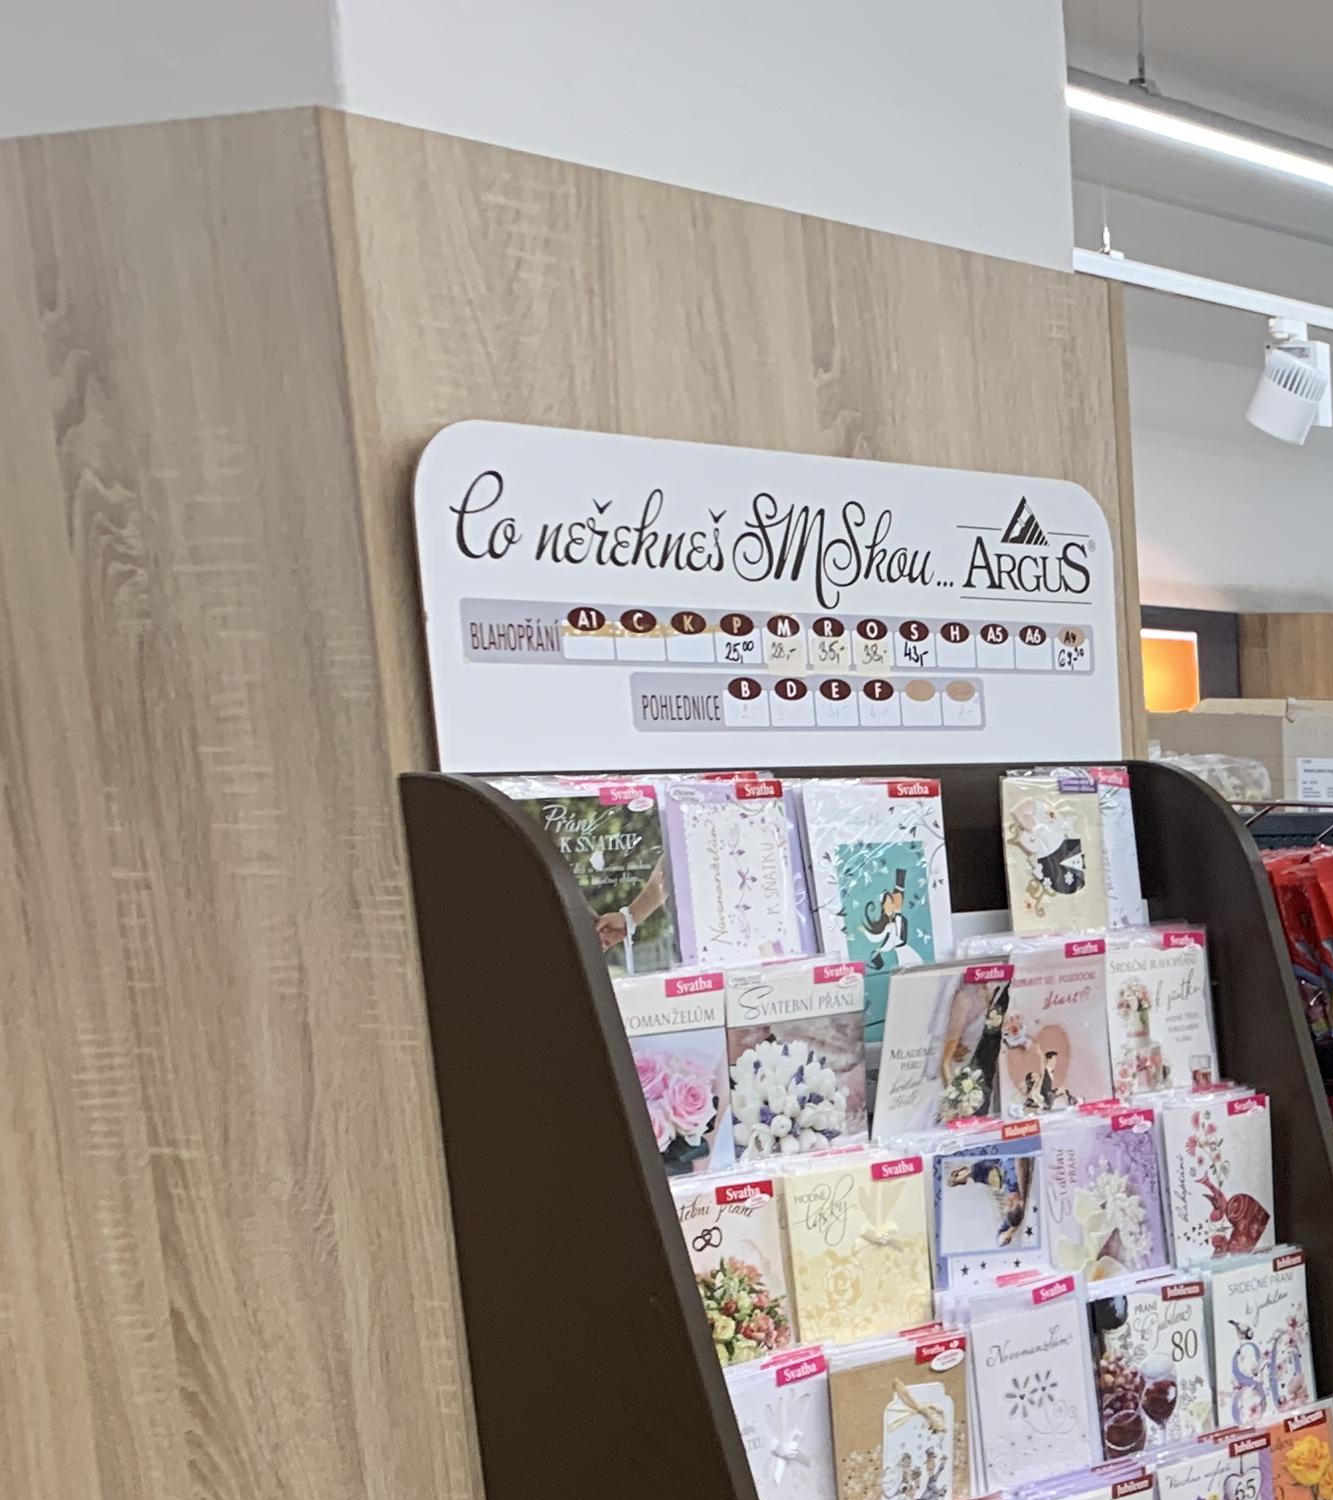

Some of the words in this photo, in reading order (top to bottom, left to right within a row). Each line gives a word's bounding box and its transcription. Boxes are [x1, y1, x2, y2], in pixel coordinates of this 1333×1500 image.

[449, 470, 523, 560] Co
[534, 488, 728, 573] neřekneš
[577, 611, 598, 629] A1
[631, 613, 644, 630] C
[682, 615, 696, 632] K
[732, 615, 742, 634] P
[776, 619, 793, 636] M
[823, 619, 833, 637] R
[469, 617, 562, 654] BLAHOPŘÁNÍ
[866, 621, 878, 639] O
[910, 622, 920, 640] S
[949, 625, 962, 642] H
[983, 626, 1003, 643] A5
[1025, 629, 1042, 645] A6
[740, 683, 752, 699] B
[785, 683, 798, 699] D
[831, 683, 841, 699] E
[874, 683, 883, 698] F
[641, 695, 721, 722] POHLEDNICE
[897, 783, 930, 797] Svatba
[1072, 941, 1099, 957] Svatba
[974, 967, 1006, 983] Svatba
[676, 977, 713, 994] Svatba
[882, 1162, 914, 1177] Svatba
[1170, 1328, 1199, 1362] 80
